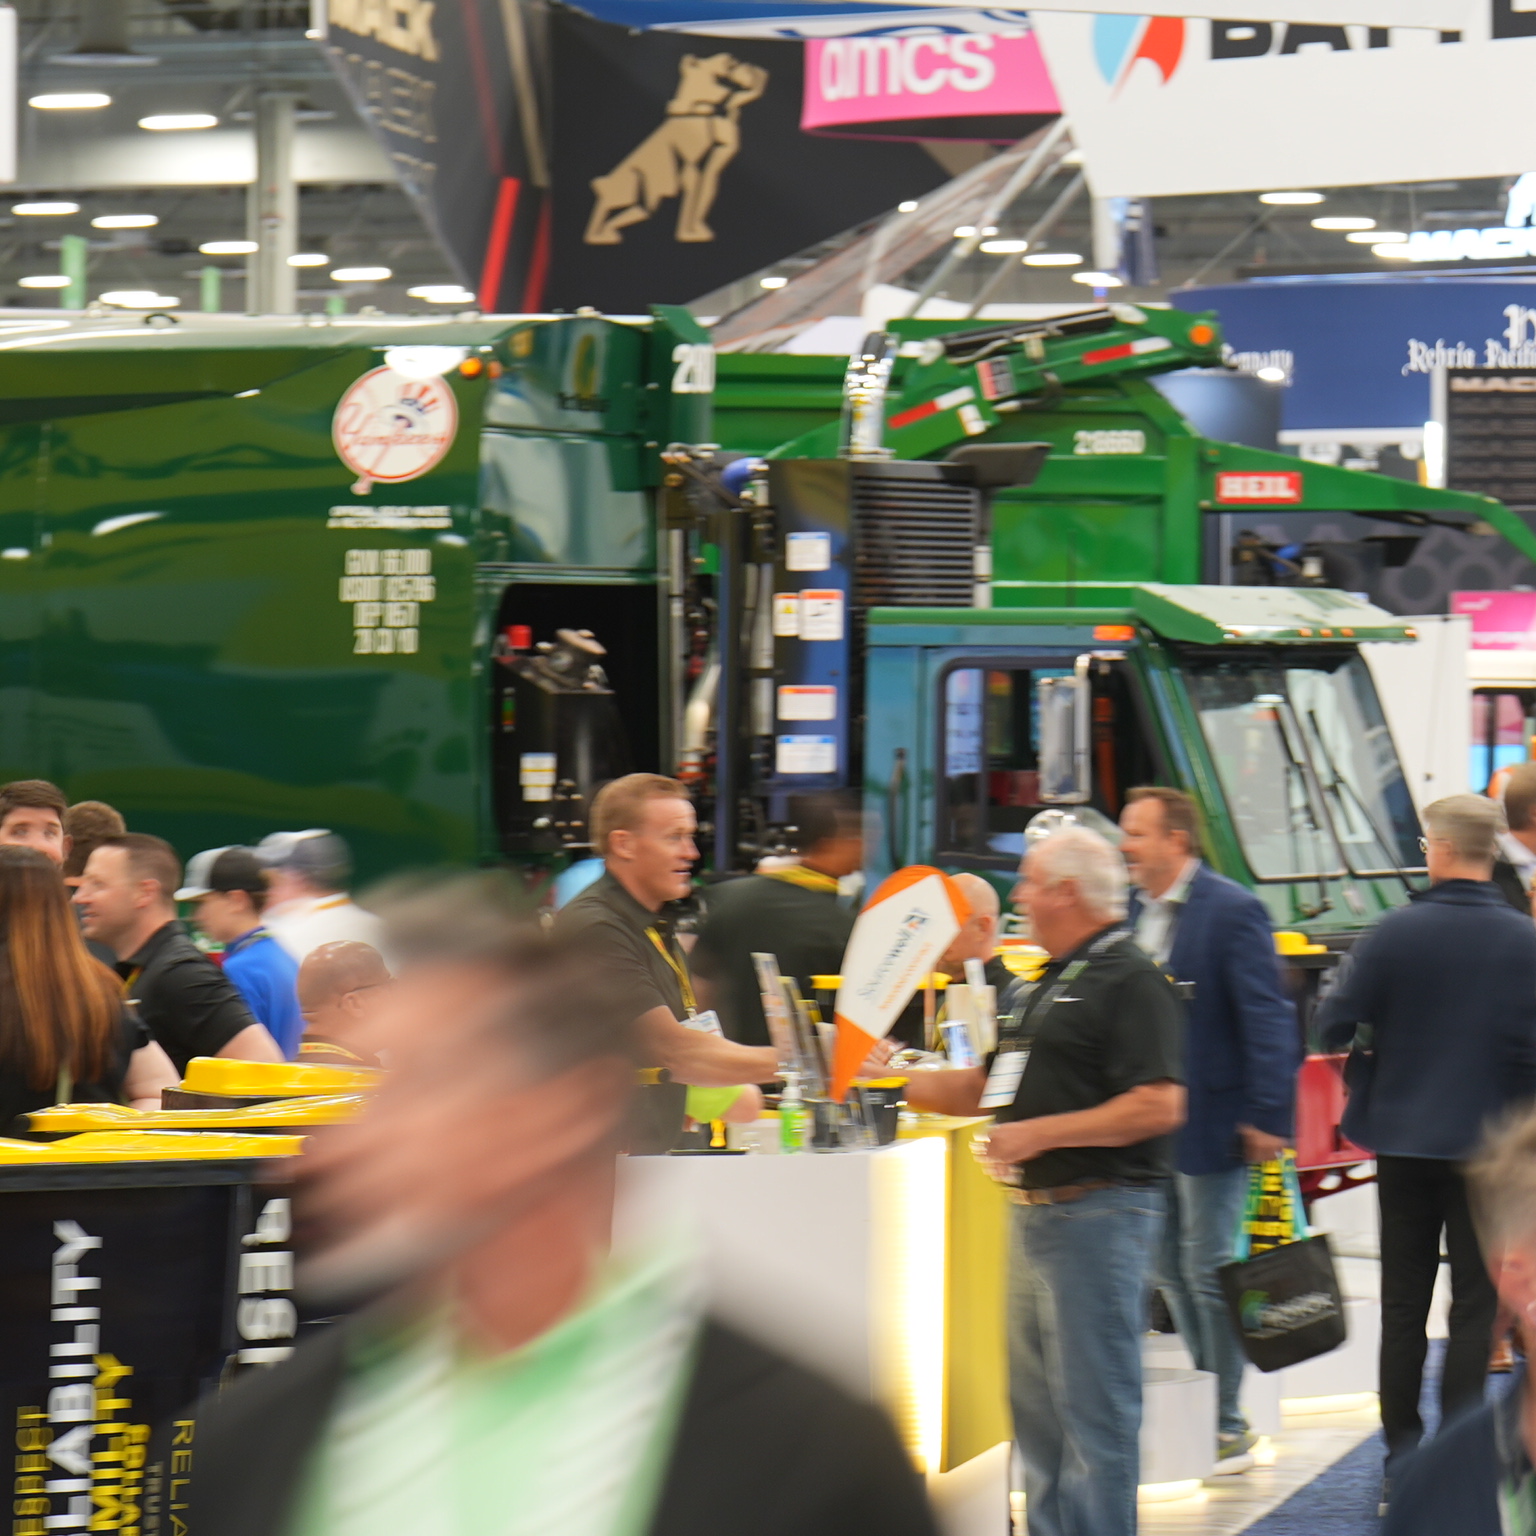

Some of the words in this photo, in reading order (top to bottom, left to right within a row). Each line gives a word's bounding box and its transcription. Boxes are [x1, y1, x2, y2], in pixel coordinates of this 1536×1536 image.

[818, 32, 996, 101] amcs
[1219, 475, 1298, 499] HEIL
[45, 1219, 103, 1536] LIABILITY
